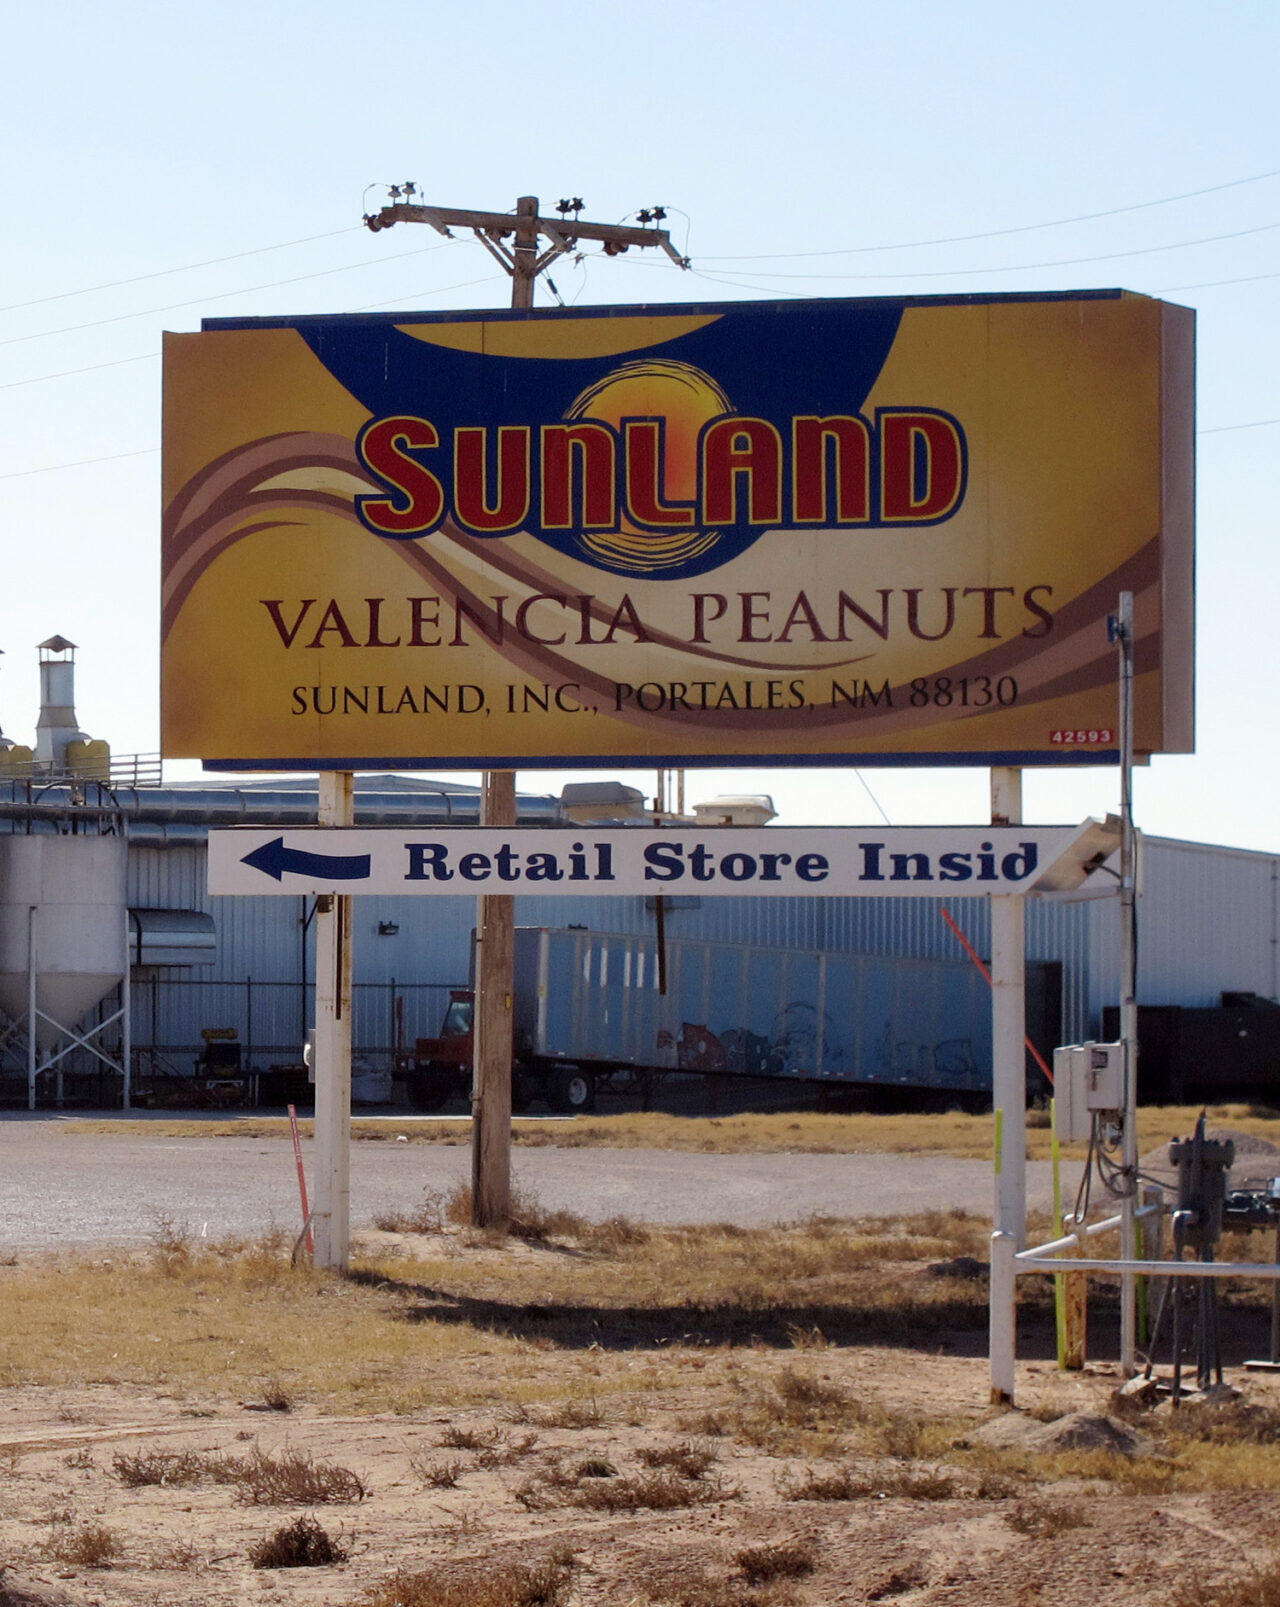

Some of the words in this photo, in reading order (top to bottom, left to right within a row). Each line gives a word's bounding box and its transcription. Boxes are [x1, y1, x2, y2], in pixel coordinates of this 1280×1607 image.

[260, 594, 656, 648] VALENCIA
[688, 585, 1054, 643] PEANUTS
[291, 684, 491, 716] SUNLAND,
[506, 683, 599, 714] INC.,
[831, 677, 893, 709] NM
[909, 675, 1019, 708] 88130
[1052, 730, 1111, 743] 42593
[404, 842, 616, 882] Retail
[644, 842, 831, 882] Store
[857, 841, 1038, 882] Insid
